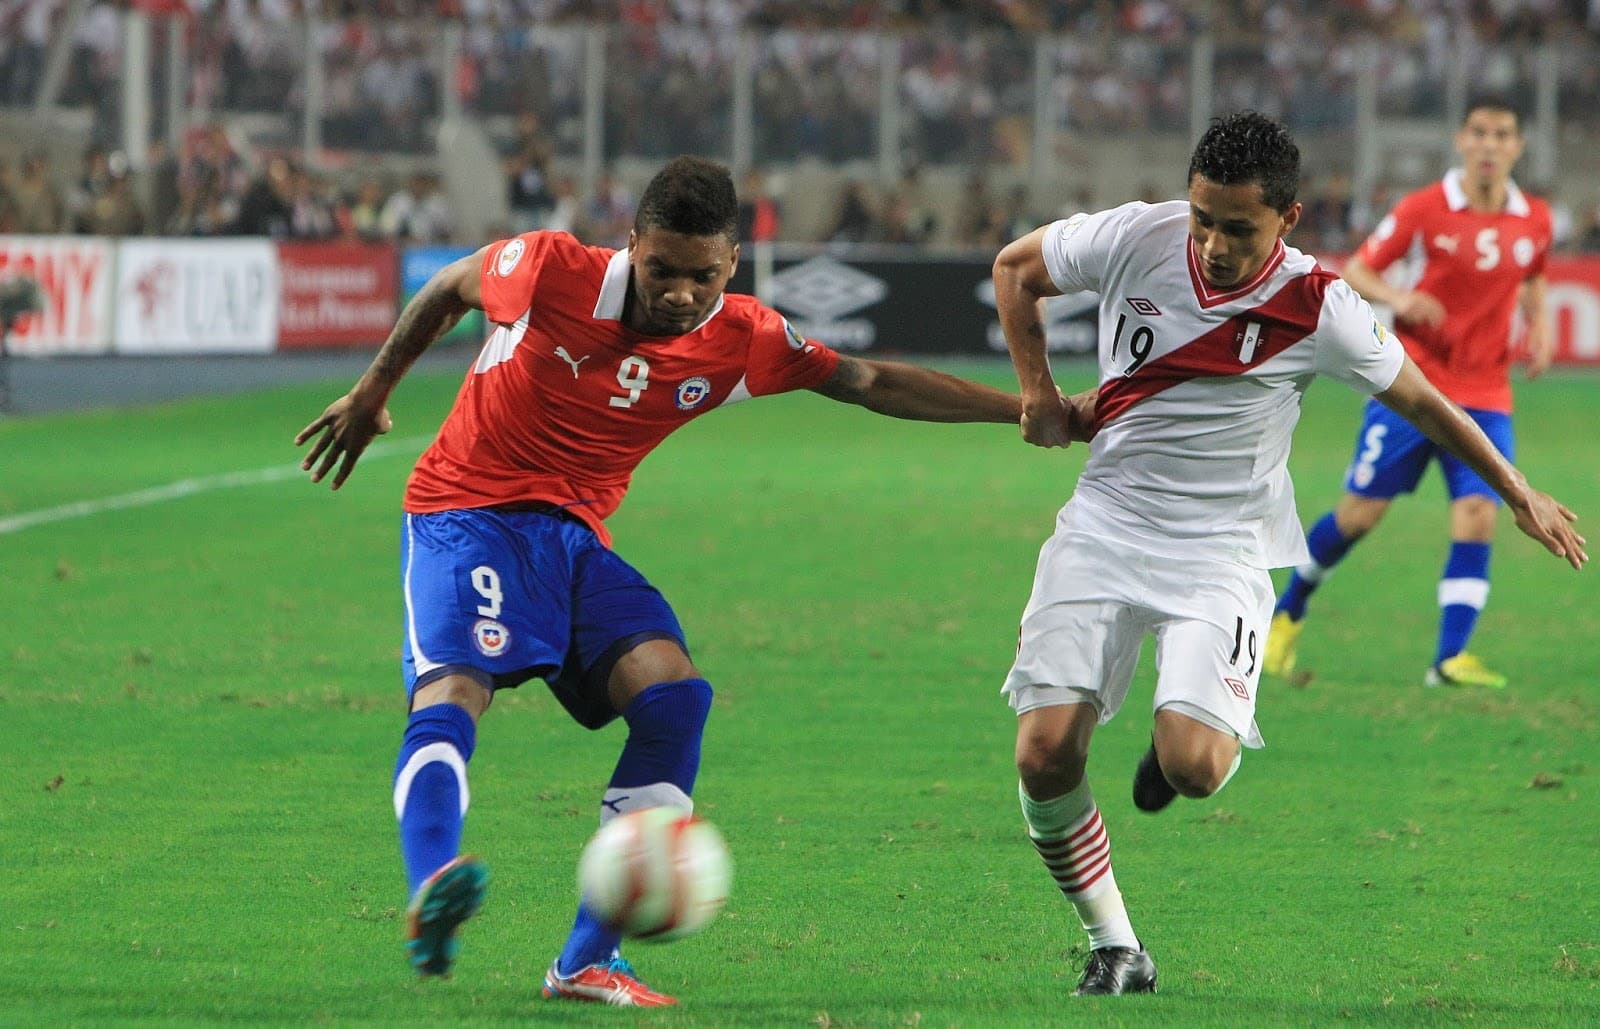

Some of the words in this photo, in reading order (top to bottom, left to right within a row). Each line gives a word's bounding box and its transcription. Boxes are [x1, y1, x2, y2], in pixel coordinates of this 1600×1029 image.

[1475, 228, 1501, 271] 5
[1111, 313, 1155, 377] 19
[608, 355, 649, 408] 9
[1360, 424, 1387, 463] 5
[470, 565, 503, 619] 9
[1229, 615, 1257, 678] 19
